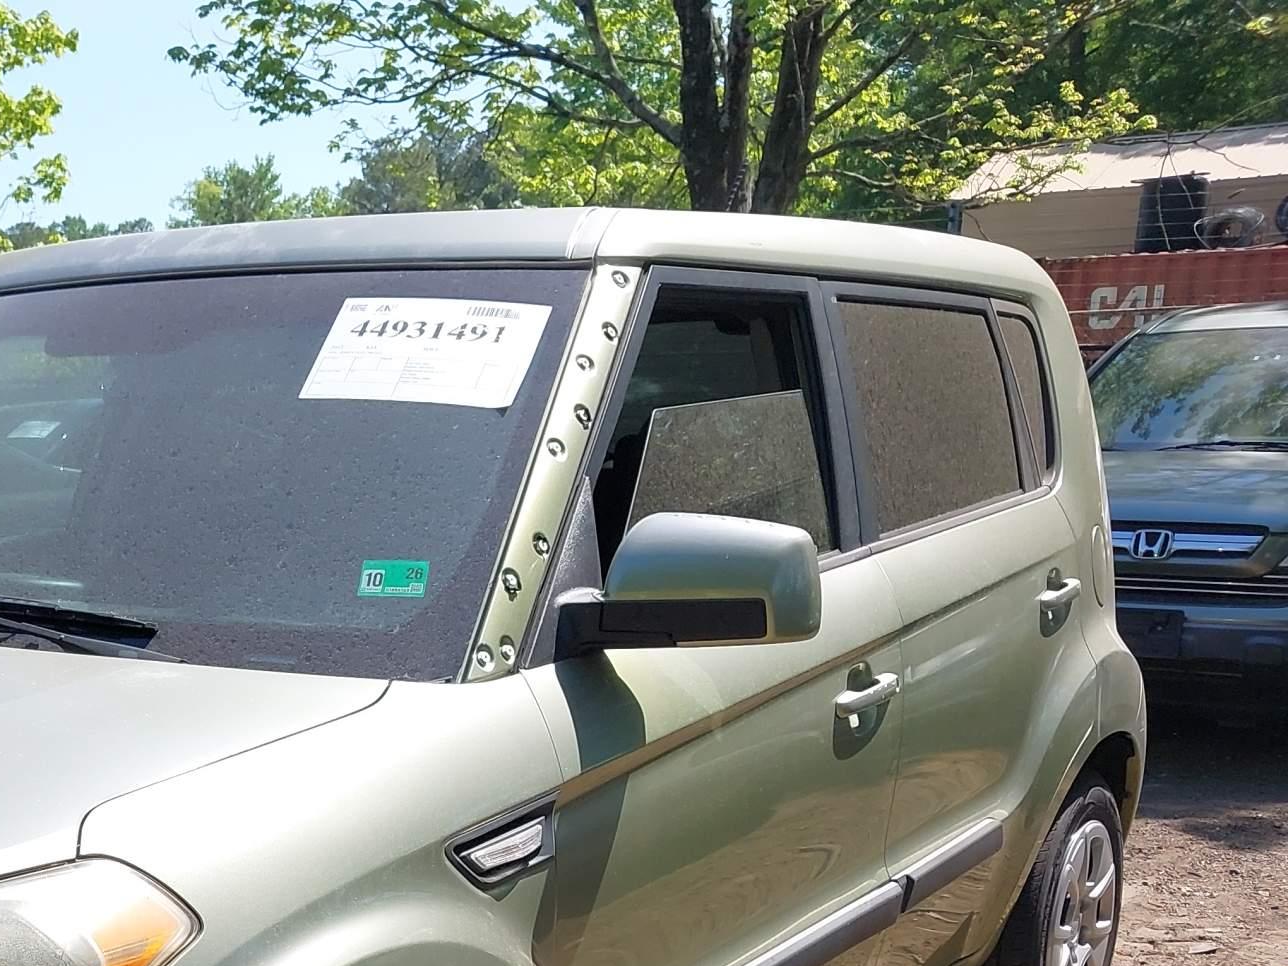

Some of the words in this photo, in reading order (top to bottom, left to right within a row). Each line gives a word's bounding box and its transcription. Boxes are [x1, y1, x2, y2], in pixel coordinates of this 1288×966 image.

[349, 318, 506, 344] 44931491
[365, 571, 384, 588] 10
[406, 567, 424, 580] 26
